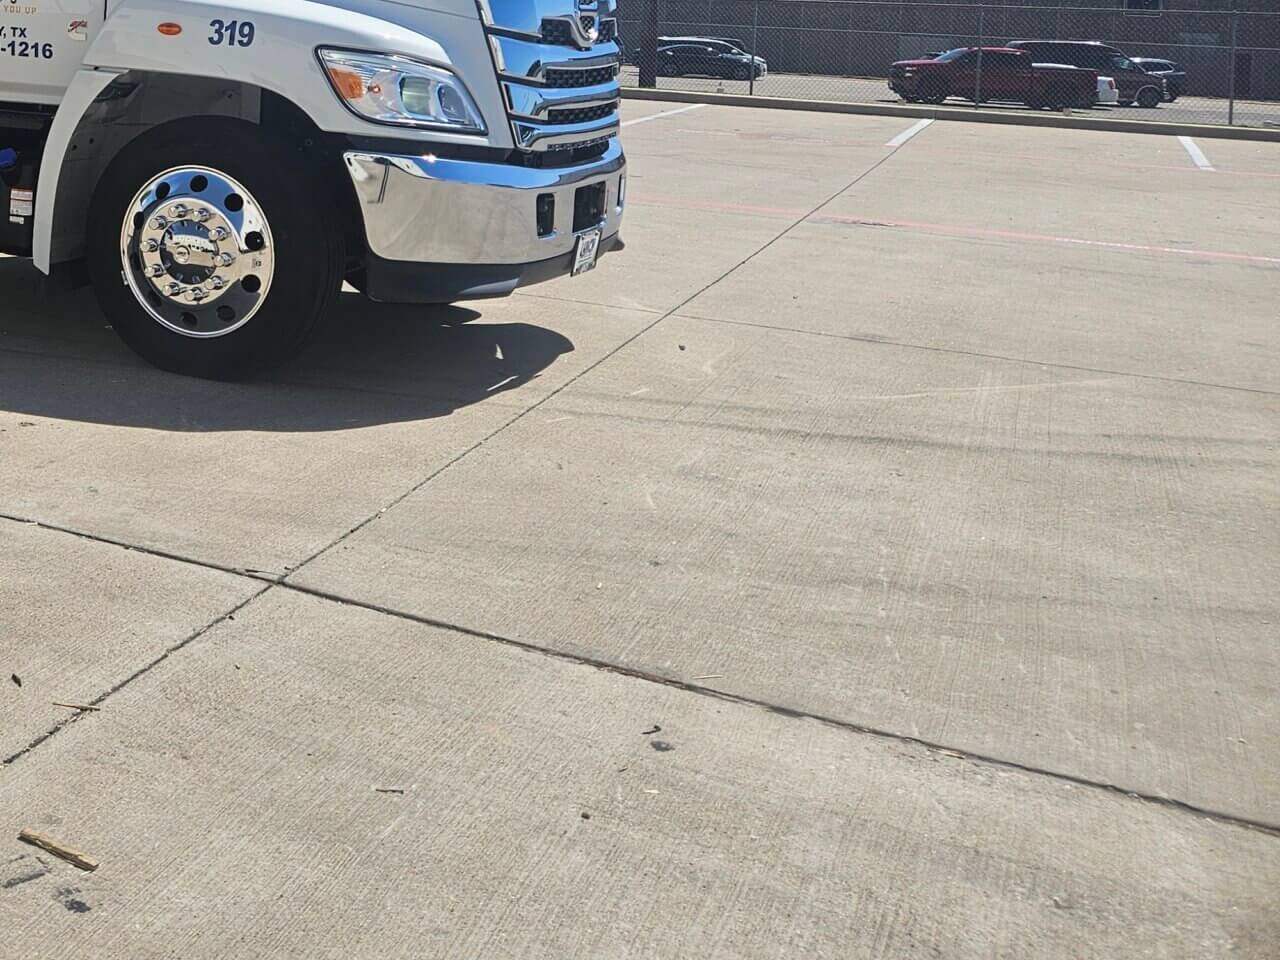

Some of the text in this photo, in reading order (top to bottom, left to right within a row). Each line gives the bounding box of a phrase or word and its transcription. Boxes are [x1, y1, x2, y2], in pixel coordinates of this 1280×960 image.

[3, 6, 21, 14] YOU
[24, 7, 38, 16] UP
[10, 26, 28, 39] TX
[207, 18, 256, 48] 319
